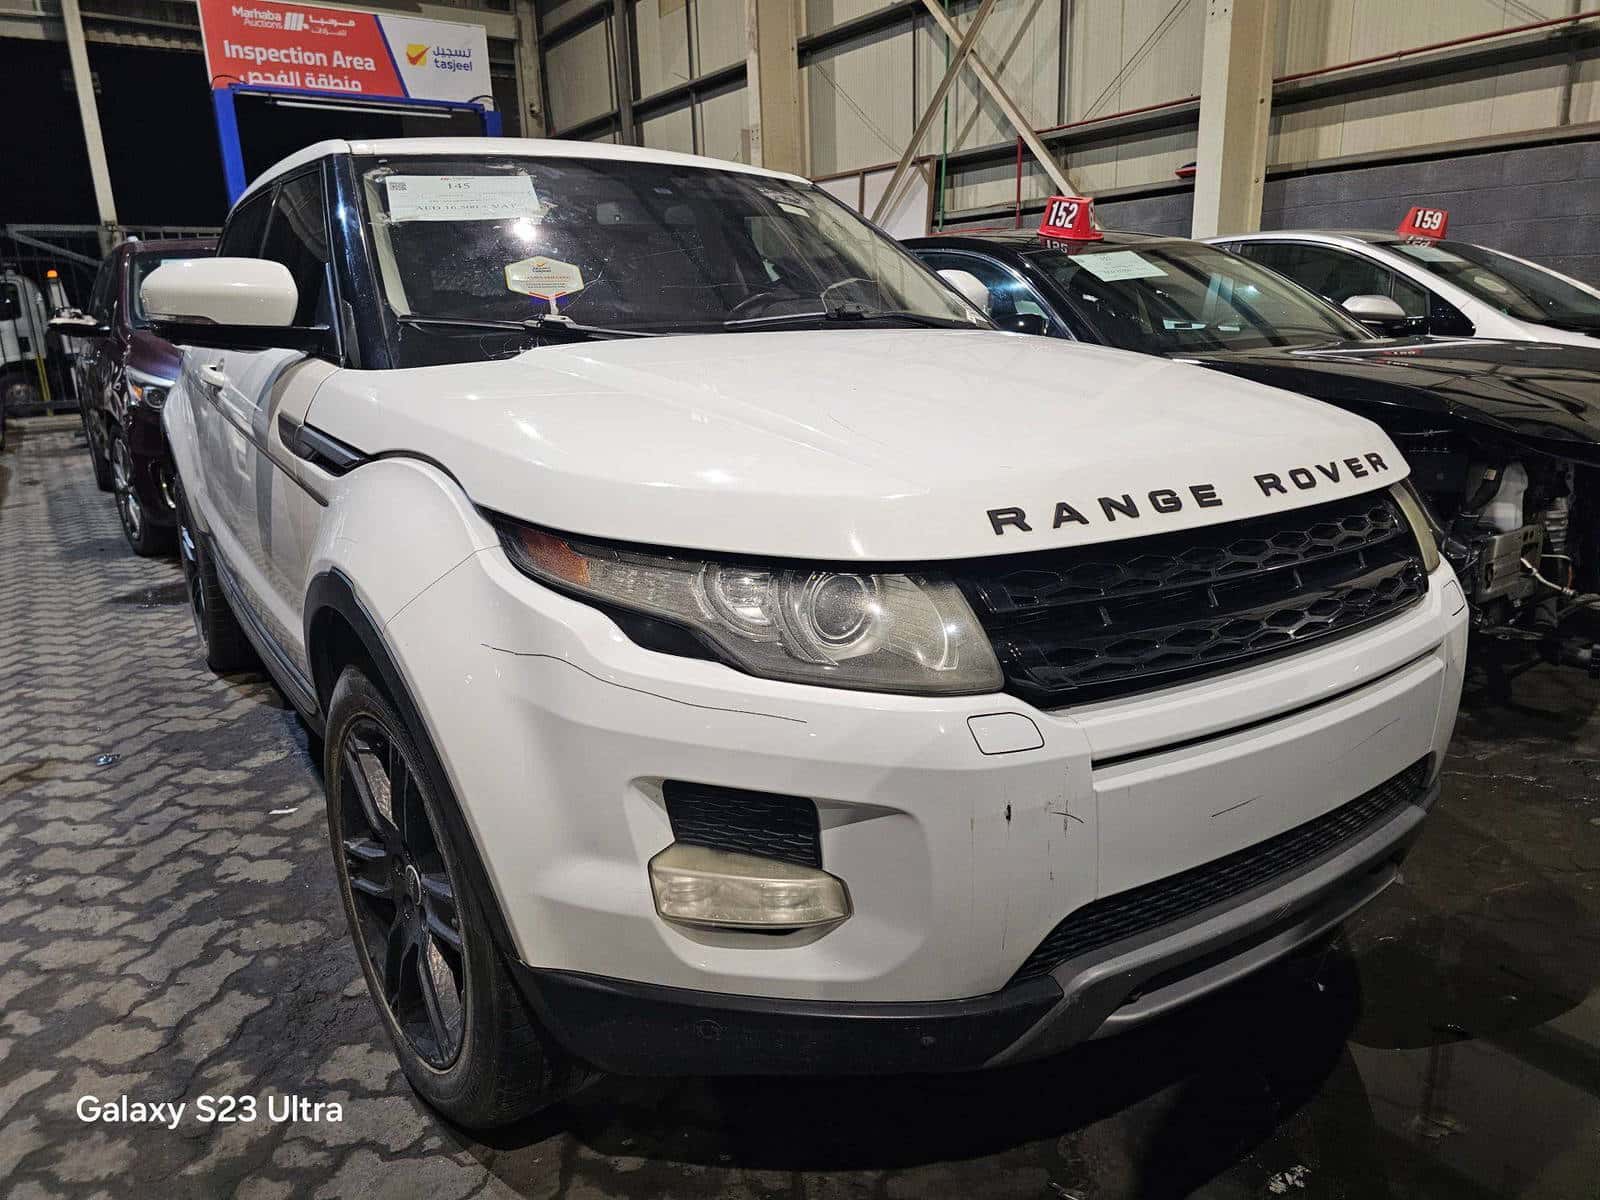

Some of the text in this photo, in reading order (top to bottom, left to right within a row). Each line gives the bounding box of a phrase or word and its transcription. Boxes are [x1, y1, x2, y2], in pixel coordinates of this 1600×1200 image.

[232, 6, 282, 22] Marhaba
[243, 19, 283, 30] Auctions
[223, 40, 377, 72] Inspection Area
[432, 46, 472, 59] تسجيل
[434, 59, 473, 73] tasjeel
[304, 72, 362, 92] منطقة
[448, 182, 471, 190] 145
[1048, 200, 1079, 229] 152
[1414, 209, 1443, 230] 159
[986, 452, 1389, 535] RANGE ROVER
